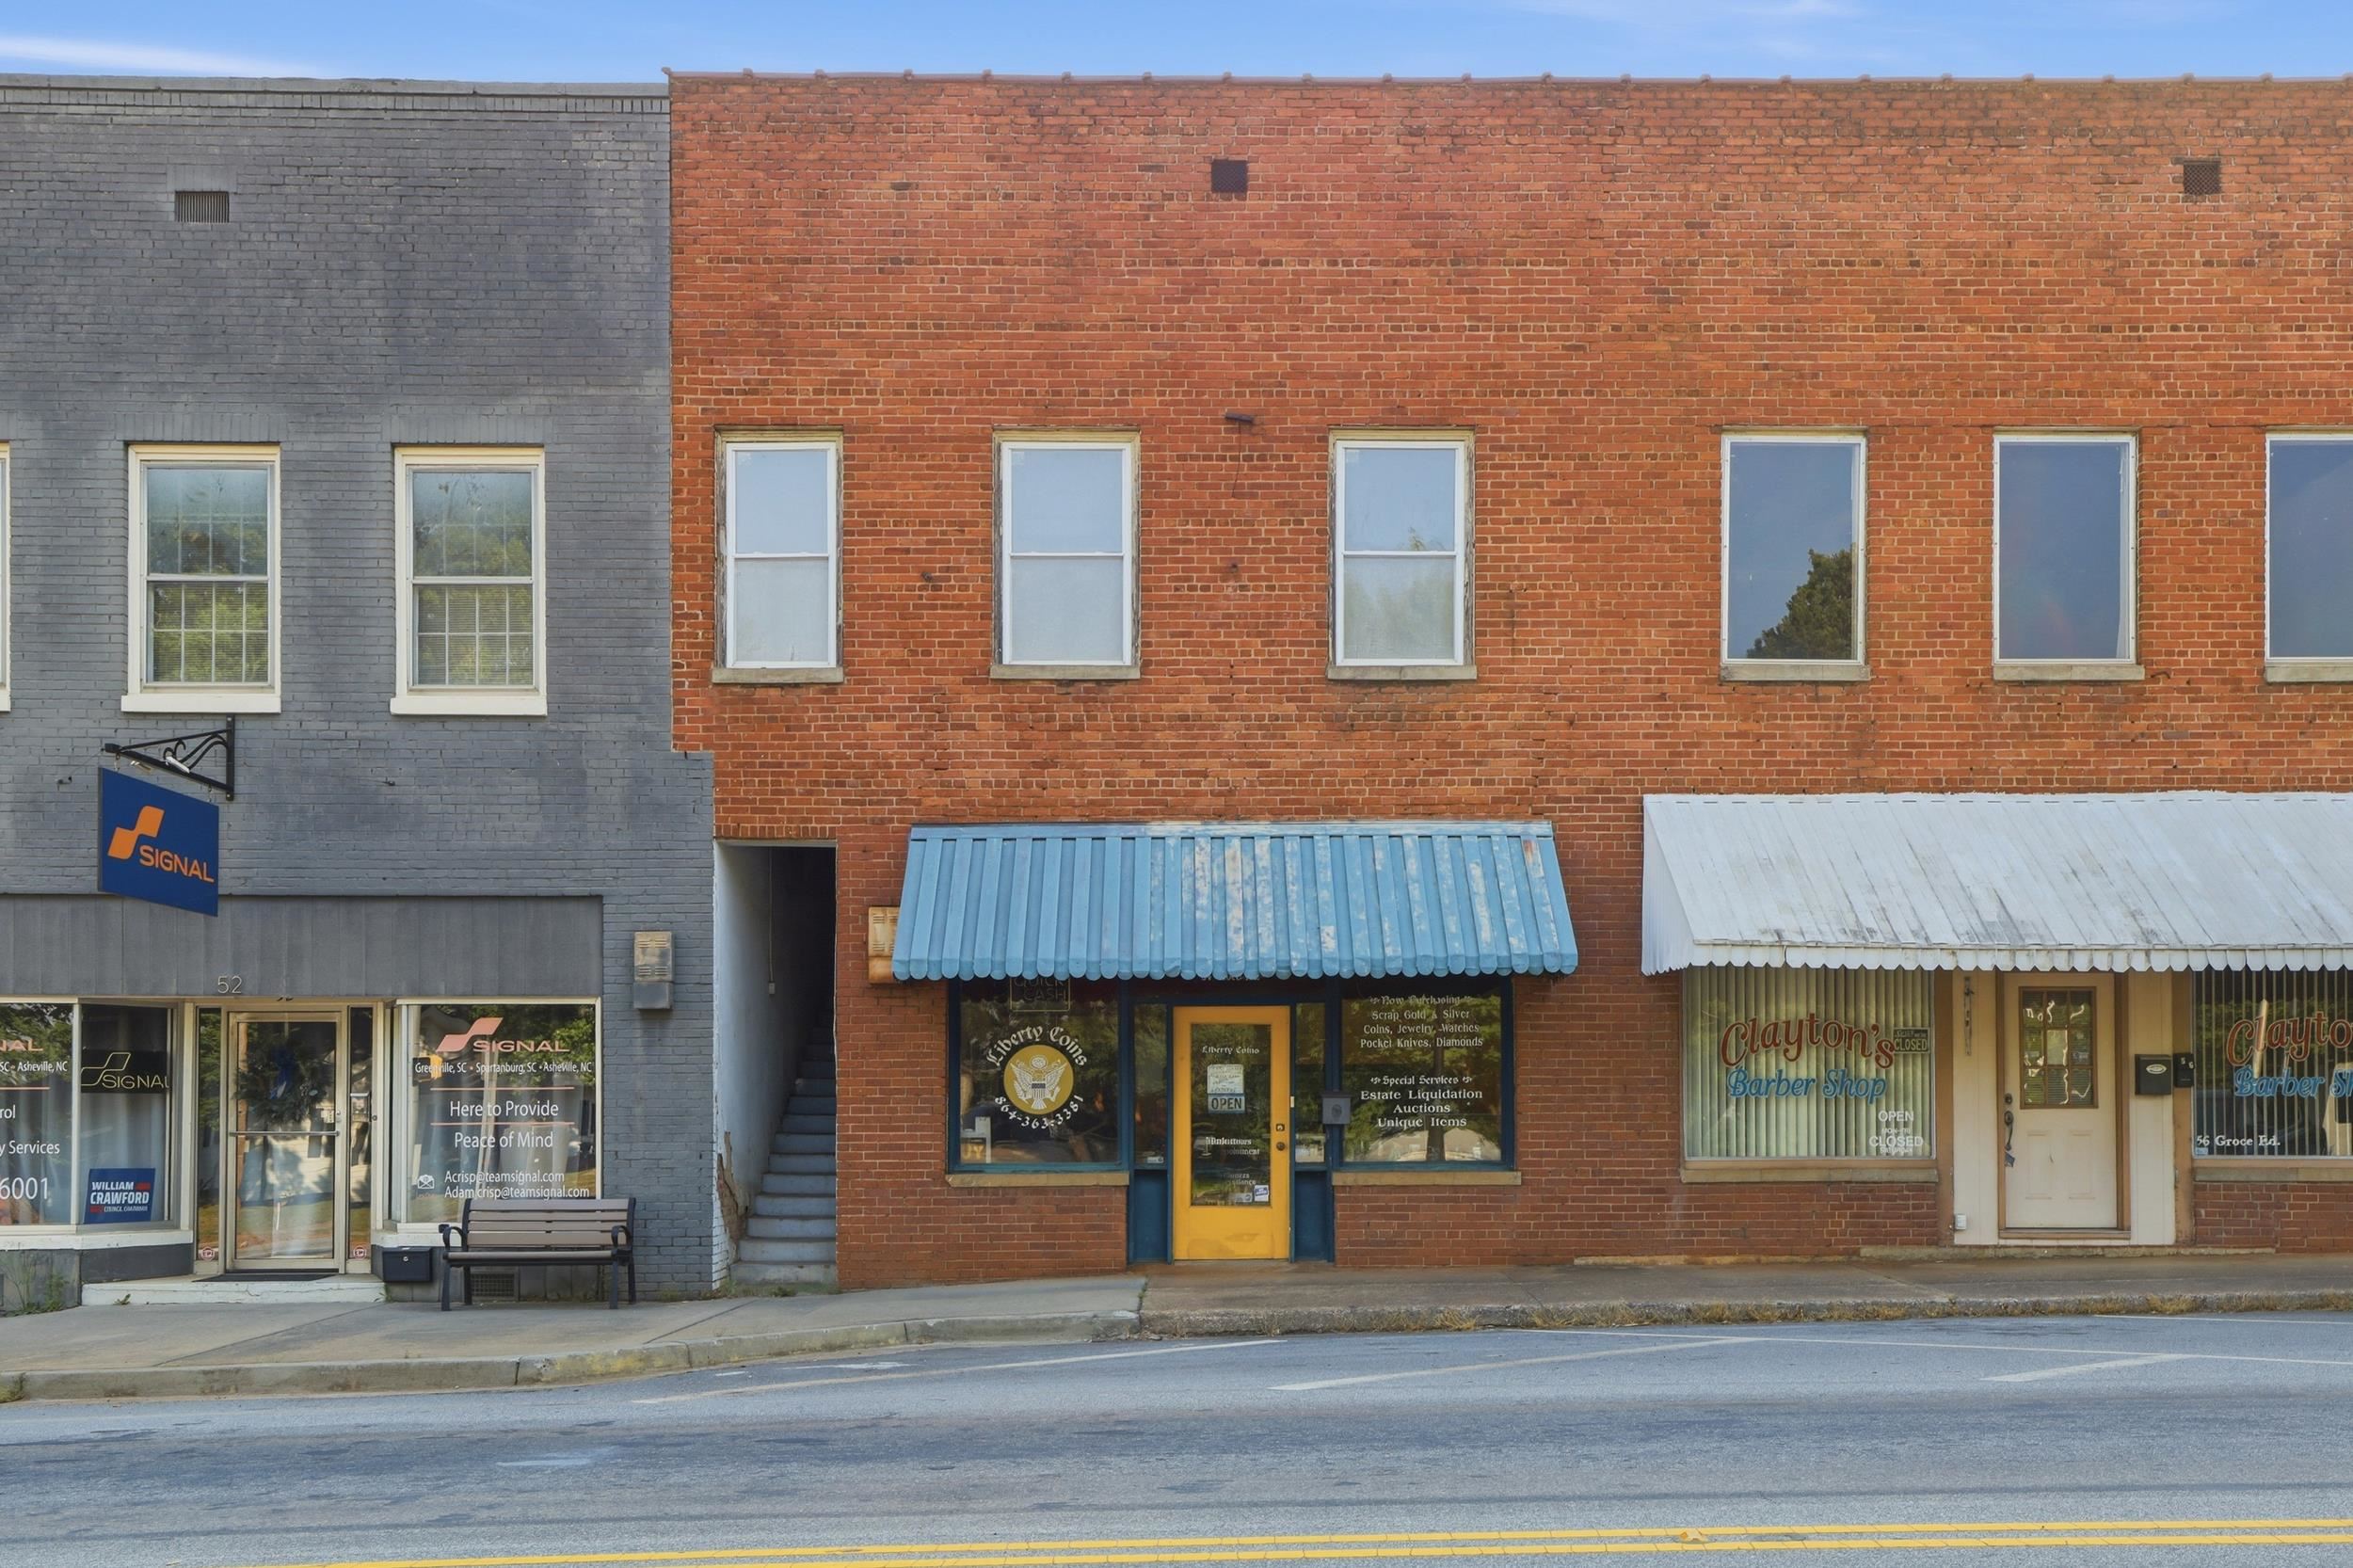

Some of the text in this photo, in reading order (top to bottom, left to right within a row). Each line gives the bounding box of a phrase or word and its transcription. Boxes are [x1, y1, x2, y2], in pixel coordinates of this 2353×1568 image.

[139, 844, 215, 884] SIGNAL
[217, 975, 243, 994] 52
[1023, 987, 1066, 1001] CASH
[1371, 1010, 1400, 1022] Scrap
[1403, 1010, 1427, 1020] Gold
[1443, 1009, 1470, 1019] Silver
[1363, 1023, 1481, 1035] Coins, Jewelry, Watches
[472, 1040, 570, 1052] SIGNAL
[985, 1025, 1088, 1066] Liberty Coins
[1360, 1036, 1483, 1048] Pocket Knives, Diamonds
[1721, 1012, 1896, 1069] Clayton's
[1894, 1038, 1928, 1051] CLOSED
[1202, 1045, 1233, 1055] Liberty
[17, 1061, 55, 1074] Asheville,
[56, 1061, 69, 1072] NC
[414, 1062, 593, 1075] Greenville, SC Spartanburg, SC Asheville, NC
[102, 1074, 170, 1090] SIGNAL
[1383, 1075, 1460, 1087] Special Services
[1728, 1065, 1887, 1104] Barber Shop
[2234, 1064, 2325, 1098] Barber
[1360, 1089, 1483, 1101] Estate Liquidation
[449, 1099, 559, 1117] Here to Provide
[1211, 1097, 1242, 1110] OPEN
[1393, 1104, 1451, 1113] Auctions
[1878, 1111, 1914, 1122] OPEN
[1377, 1117, 1467, 1130] Unique Items
[455, 1131, 553, 1148] Peace of Mind
[1868, 1135, 1924, 1147] CLOSED
[2196, 1135, 2210, 1146] 56
[2215, 1135, 2253, 1146] Groce
[8, 1140, 60, 1154] Services
[444, 1170, 565, 1186] Acrisp@teamsignal.com
[0, 1176, 48, 1200] 6001
[91, 1181, 135, 1191] WILLIAM
[89, 1192, 150, 1205] CRAWFORD
